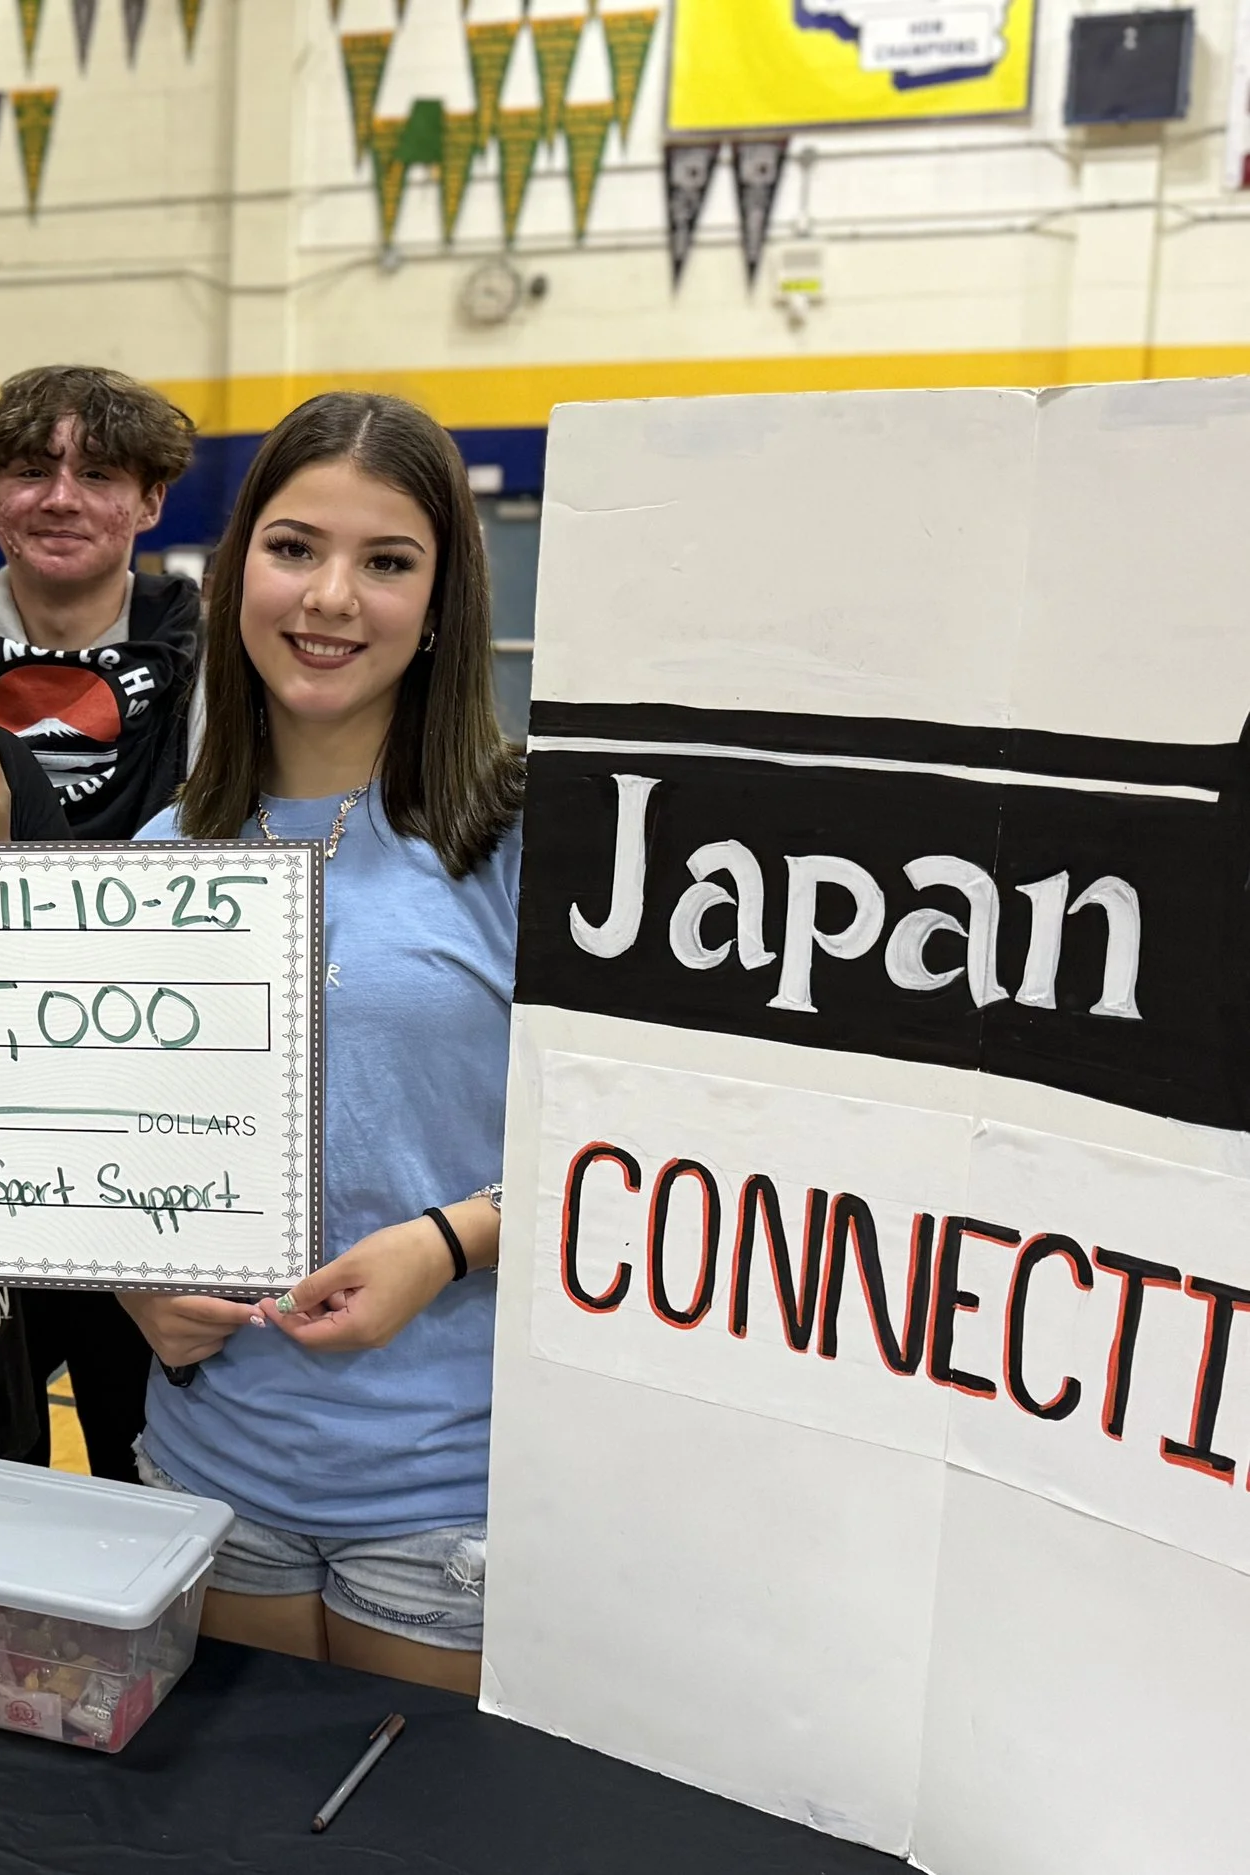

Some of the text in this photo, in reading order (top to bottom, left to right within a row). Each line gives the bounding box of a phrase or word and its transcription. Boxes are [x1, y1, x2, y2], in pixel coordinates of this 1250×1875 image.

[0, 876, 268, 931] 11-10-25
[569, 773, 1143, 1020] Japan
[138, 1113, 257, 1137] DOLLARS
[98, 1162, 241, 1235] Support
[560, 1140, 1250, 1492] CONNECTI
